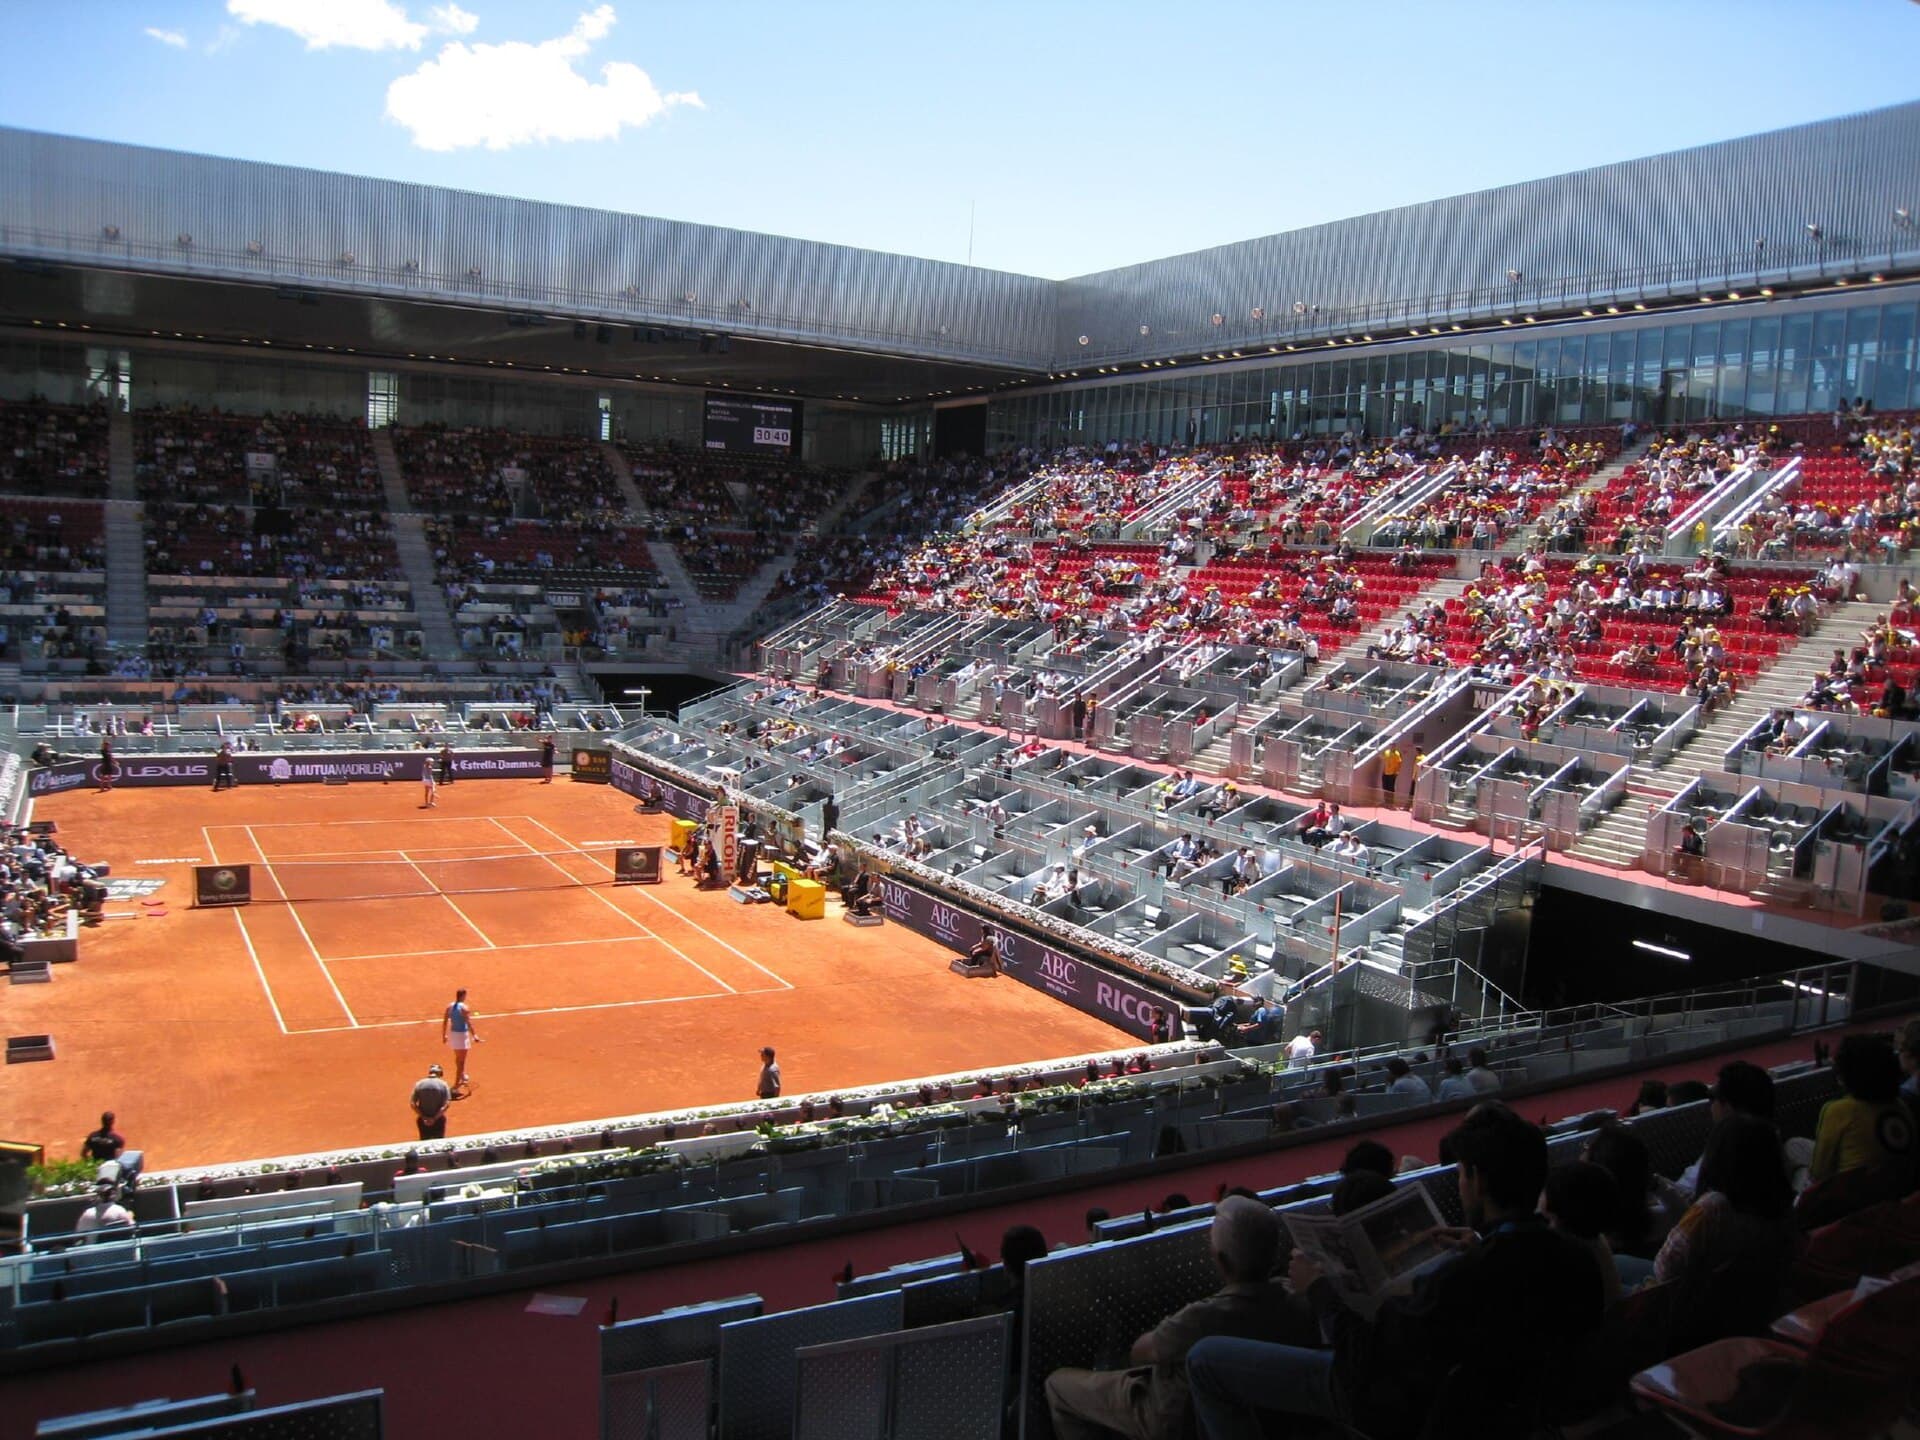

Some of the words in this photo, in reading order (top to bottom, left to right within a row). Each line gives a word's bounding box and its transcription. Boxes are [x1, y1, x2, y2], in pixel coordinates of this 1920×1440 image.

[756, 429, 770, 441] 30
[773, 431, 789, 442] 40
[127, 765, 208, 777] LEXUS
[460, 759, 496, 770] Estrella
[724, 815, 735, 871] RICOH
[885, 884, 911, 910] ABC
[931, 904, 960, 932] ABC
[994, 930, 1016, 957] BC
[1040, 952, 1077, 984] ABC
